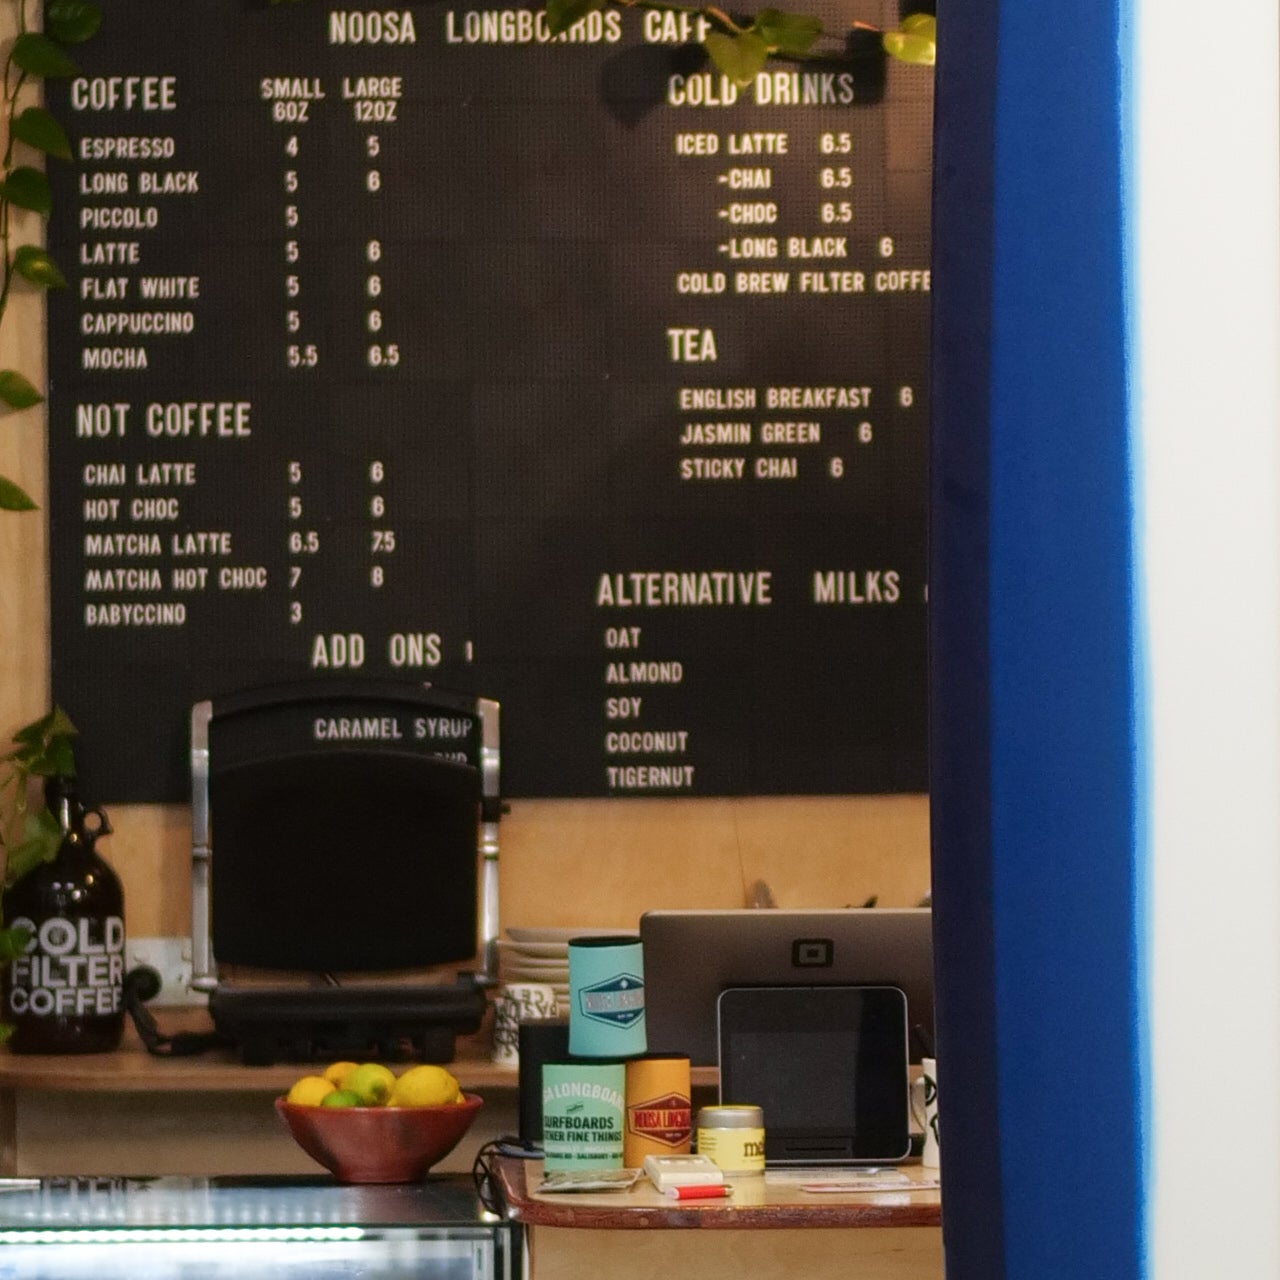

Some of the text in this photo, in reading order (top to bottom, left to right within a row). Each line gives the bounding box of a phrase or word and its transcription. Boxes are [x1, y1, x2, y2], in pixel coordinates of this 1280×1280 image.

[330, 11, 415, 43] NOOSA
[446, 10, 622, 43] LONGBORDS
[72, 77, 176, 110] COFFEE
[262, 77, 401, 98] SMALL LARGE
[668, 73, 853, 106] COLD DRINKS
[274, 100, 396, 122] 6OZ 12OZ
[81, 136, 379, 158] ESPRESSO 4 5
[676, 133, 851, 154] ICED LATTE 6.5
[81, 171, 380, 193] LONG BLACK 5 6
[719, 168, 851, 189] -CHAI 6.5
[81, 206, 298, 228] PICCOLO 5
[719, 202, 852, 224] -CHOC 6.5
[81, 241, 380, 264] LATTE 5 6
[719, 237, 893, 258] -LONG BLACK 6
[82, 275, 381, 299] FLAT WHITE 5 6
[677, 270, 930, 293] COLD BREW FILTER COFFE
[82, 310, 381, 333] CAPPUCCINO 5 6
[668, 329, 716, 361] TEA
[83, 345, 399, 369] MOCHA 5.5 6.5
[680, 387, 912, 409] ENGLISH BREAKFAST 6
[77, 403, 250, 436] NOT COFFEE
[681, 422, 872, 444] JASMIN GREEN 6
[84, 462, 383, 485] CHAI LATTE 5 6
[681, 457, 843, 479] STICKY CHAI 6
[85, 496, 384, 520] HOT CHOC 5 6
[85, 531, 395, 555] MATCHA LATTE 6.5 7.5
[86, 566, 383, 590] MATCHA HOT CHOC 7 8
[598, 572, 771, 606] ALTERNATIVE
[814, 571, 899, 603] MILKS
[86, 602, 301, 625] BABYCCINO 3
[606, 627, 640, 648] OAT
[313, 634, 364, 667] ADD
[390, 634, 440, 666] ONS
[606, 662, 682, 684] ALMOND
[607, 697, 641, 718] SOY
[315, 718, 471, 739] CARAMEL SYRUP
[606, 731, 688, 753] COCONUT
[608, 766, 694, 787] TIGERNUT
[10, 916, 125, 955] COLD
[11, 955, 124, 987] FILTER
[567, 1131, 589, 1142] FINE
[592, 1130, 622, 1142] THINGS
